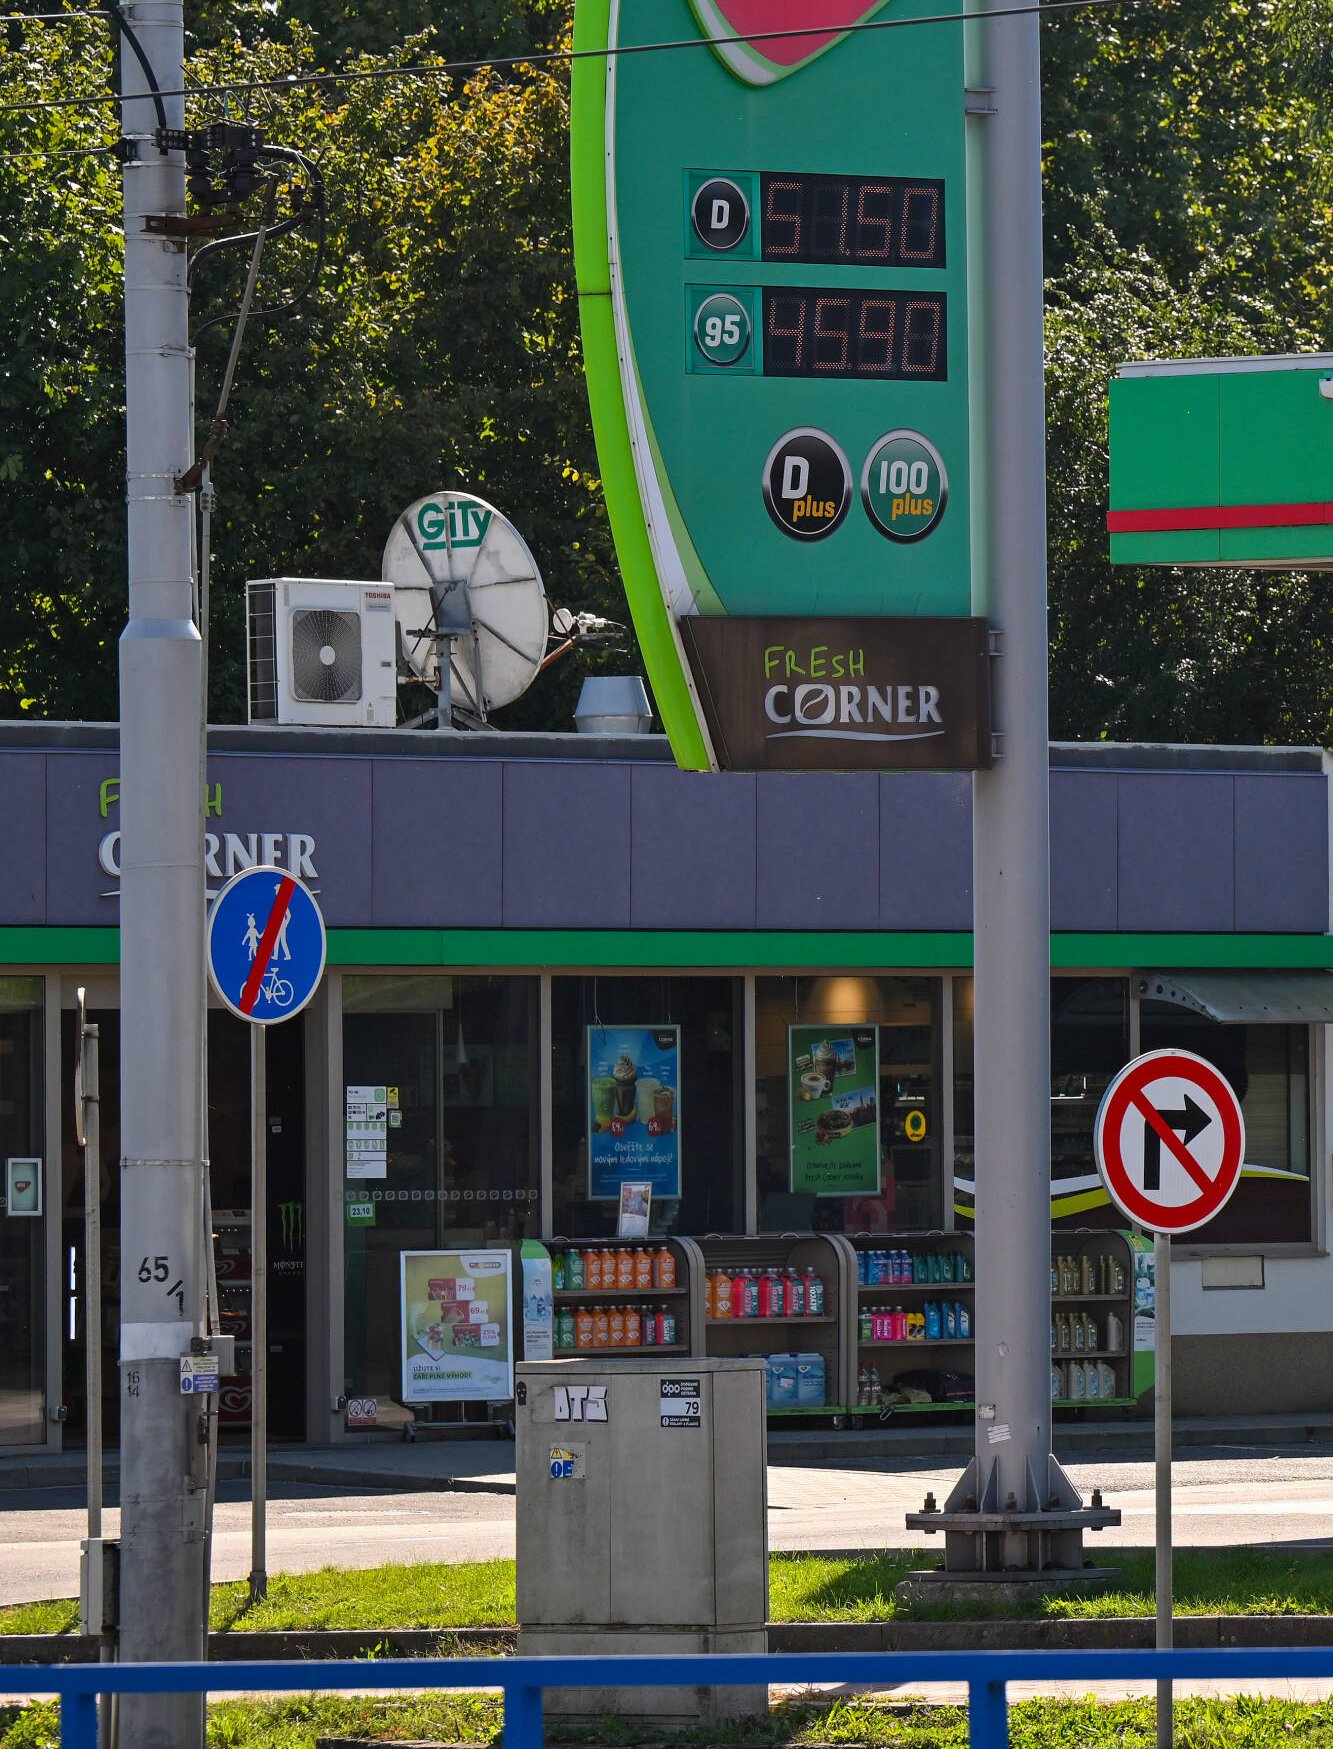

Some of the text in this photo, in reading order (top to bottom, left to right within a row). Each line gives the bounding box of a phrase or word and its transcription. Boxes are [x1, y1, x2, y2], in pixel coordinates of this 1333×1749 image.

[711, 199, 730, 229] D
[704, 314, 741, 347] 95
[781, 455, 809, 499] D
[879, 460, 929, 495] 100
[792, 495, 836, 522] plus
[892, 493, 933, 520] plus
[364, 591, 391, 599] TOSHIBA
[763, 645, 866, 679] FRESH
[764, 683, 945, 726] CORNER
[98, 830, 319, 878] CRNER
[138, 1256, 168, 1284] 65
[662, 1381, 681, 1396] dpo
[685, 1401, 699, 1414] 79
